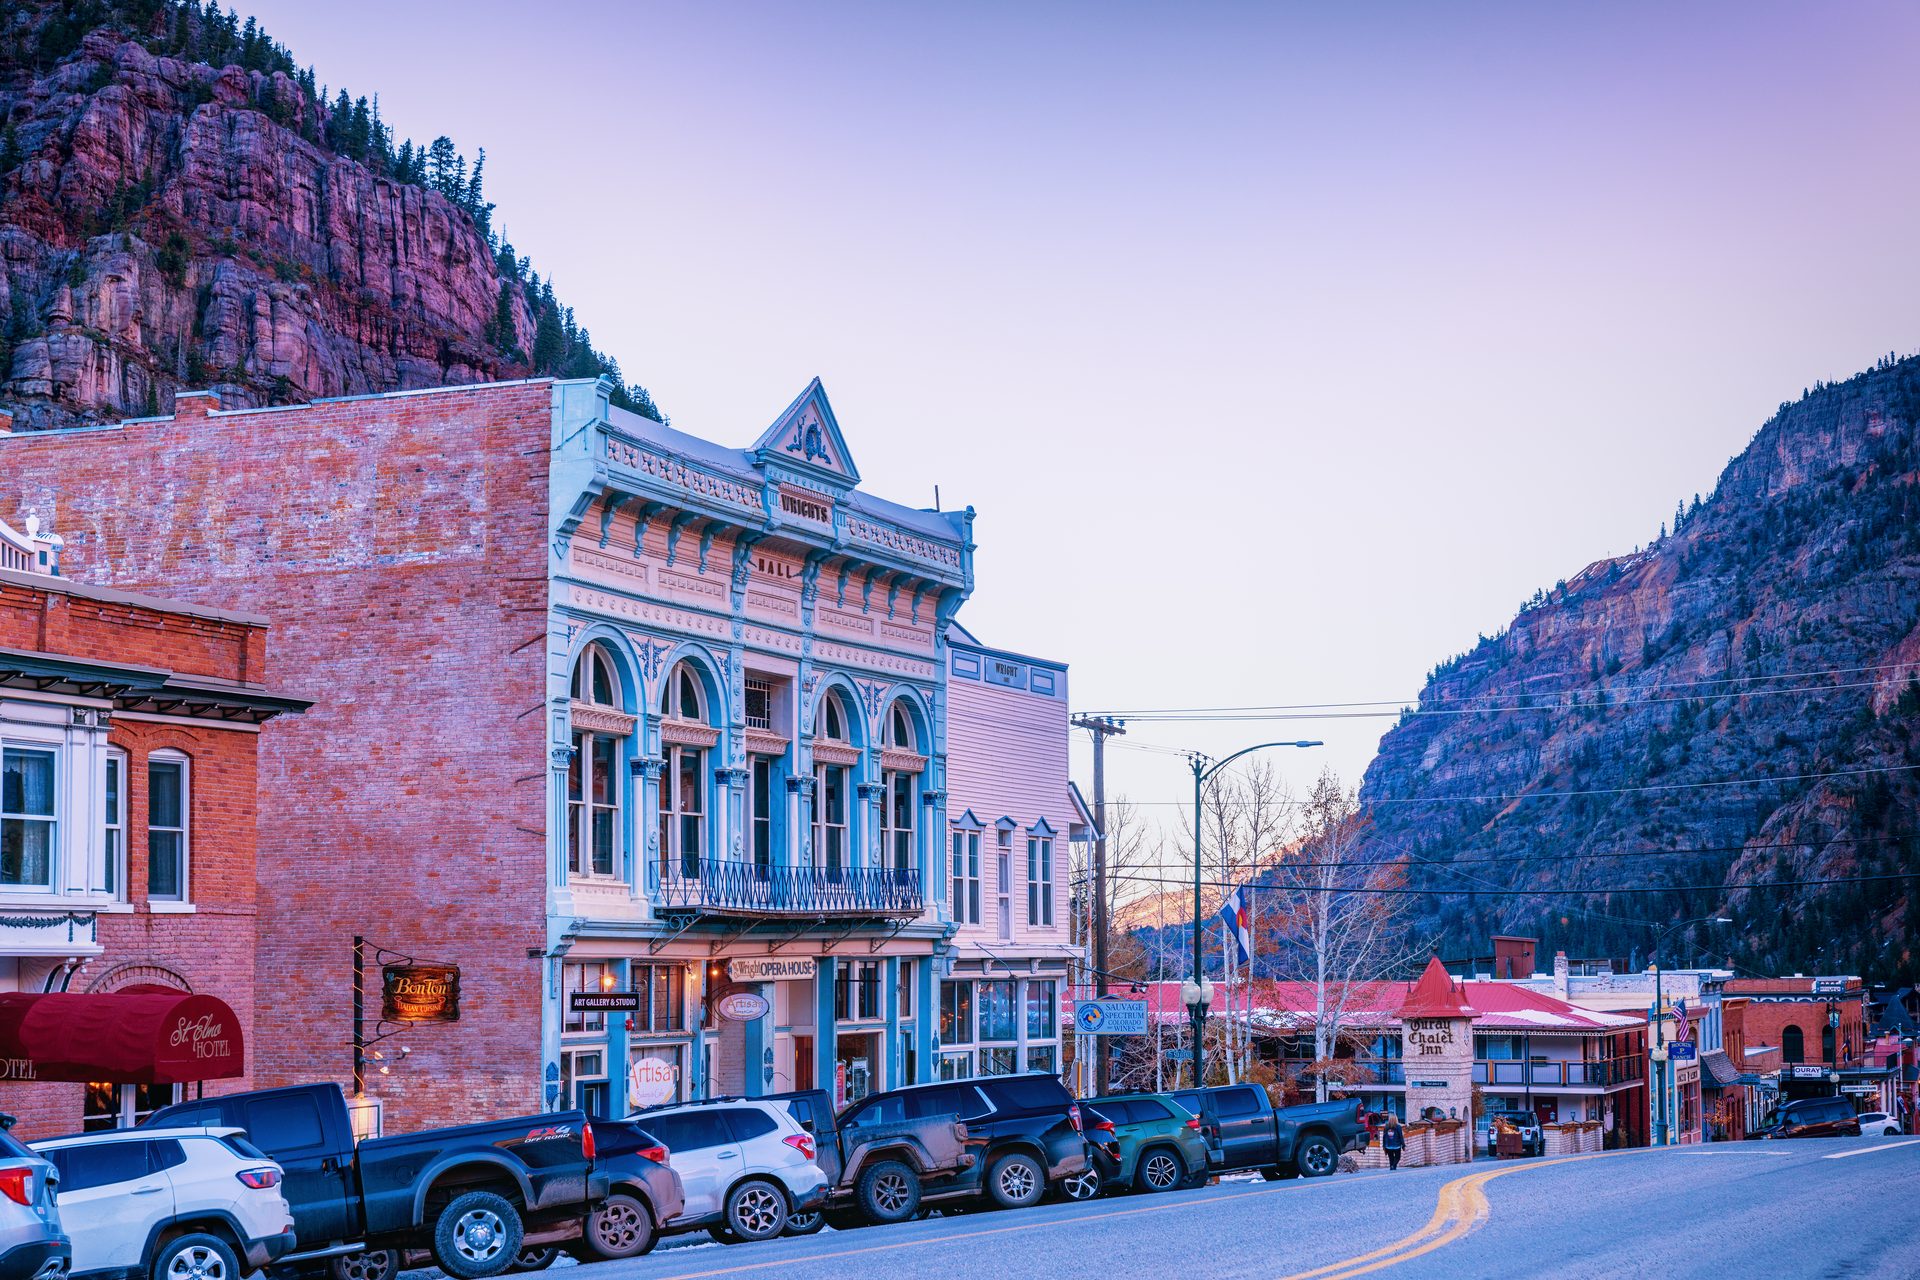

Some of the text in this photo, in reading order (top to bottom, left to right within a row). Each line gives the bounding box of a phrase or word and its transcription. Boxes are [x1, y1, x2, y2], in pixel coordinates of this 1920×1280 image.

[780, 494, 828, 522] WRIGHTS
[758, 558, 792, 578] HALL
[995, 662, 1018, 678] WRIGHT
[738, 960, 761, 978] Wright
[761, 962, 787, 976] OPERA
[788, 961, 812, 975] HOUSE
[726, 996, 763, 1009] Artisan
[170, 1013, 222, 1052] St. Elmo
[1409, 1032, 1454, 1045] Chalet
[197, 1040, 230, 1058] HOTEL
[1419, 1044, 1442, 1055] Inn
[630, 1052, 679, 1089] Artisan
[527, 1125, 571, 1139] FX4
